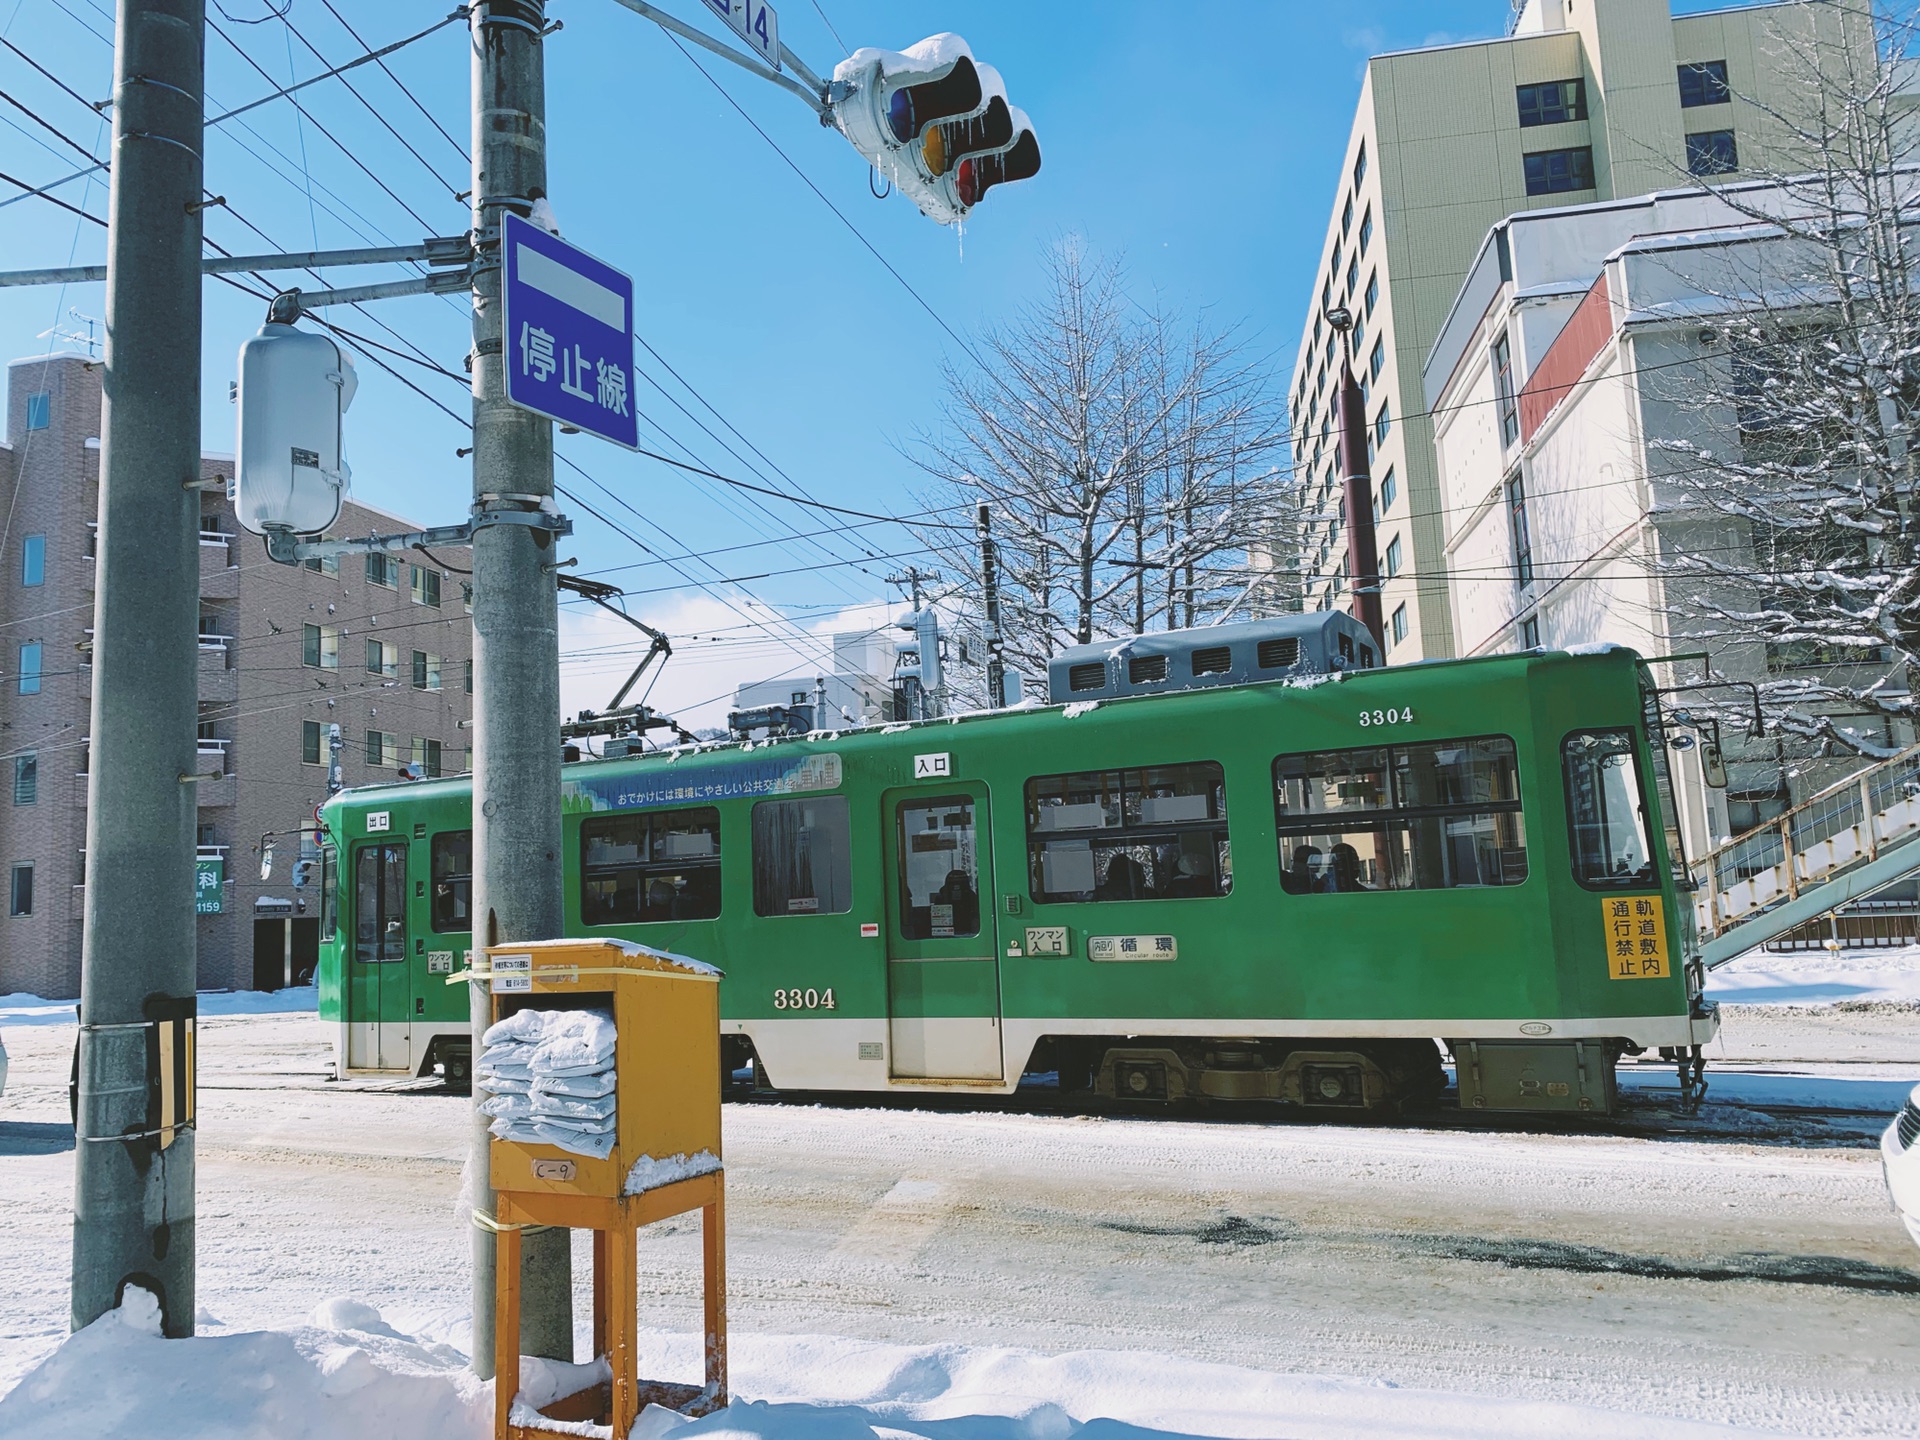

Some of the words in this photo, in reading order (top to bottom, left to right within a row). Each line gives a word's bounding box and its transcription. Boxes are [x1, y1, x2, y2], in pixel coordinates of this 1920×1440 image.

[519, 320, 630, 418] 停止線
[1359, 706, 1414, 727] 3304
[918, 757, 946, 773] 入口
[369, 815, 388, 828] 出口
[1027, 930, 1064, 940] ワンマン
[1611, 900, 1638, 976] 通行禁止
[1635, 899, 1661, 976] 軌道敷内
[1032, 941, 1062, 952] 入口
[1094, 940, 1113, 952] 内回り
[1120, 937, 1173, 952] 循環
[431, 962, 450, 970] 出口
[774, 988, 835, 1009] 3304
[536, 1164, 569, 1182] C-9
